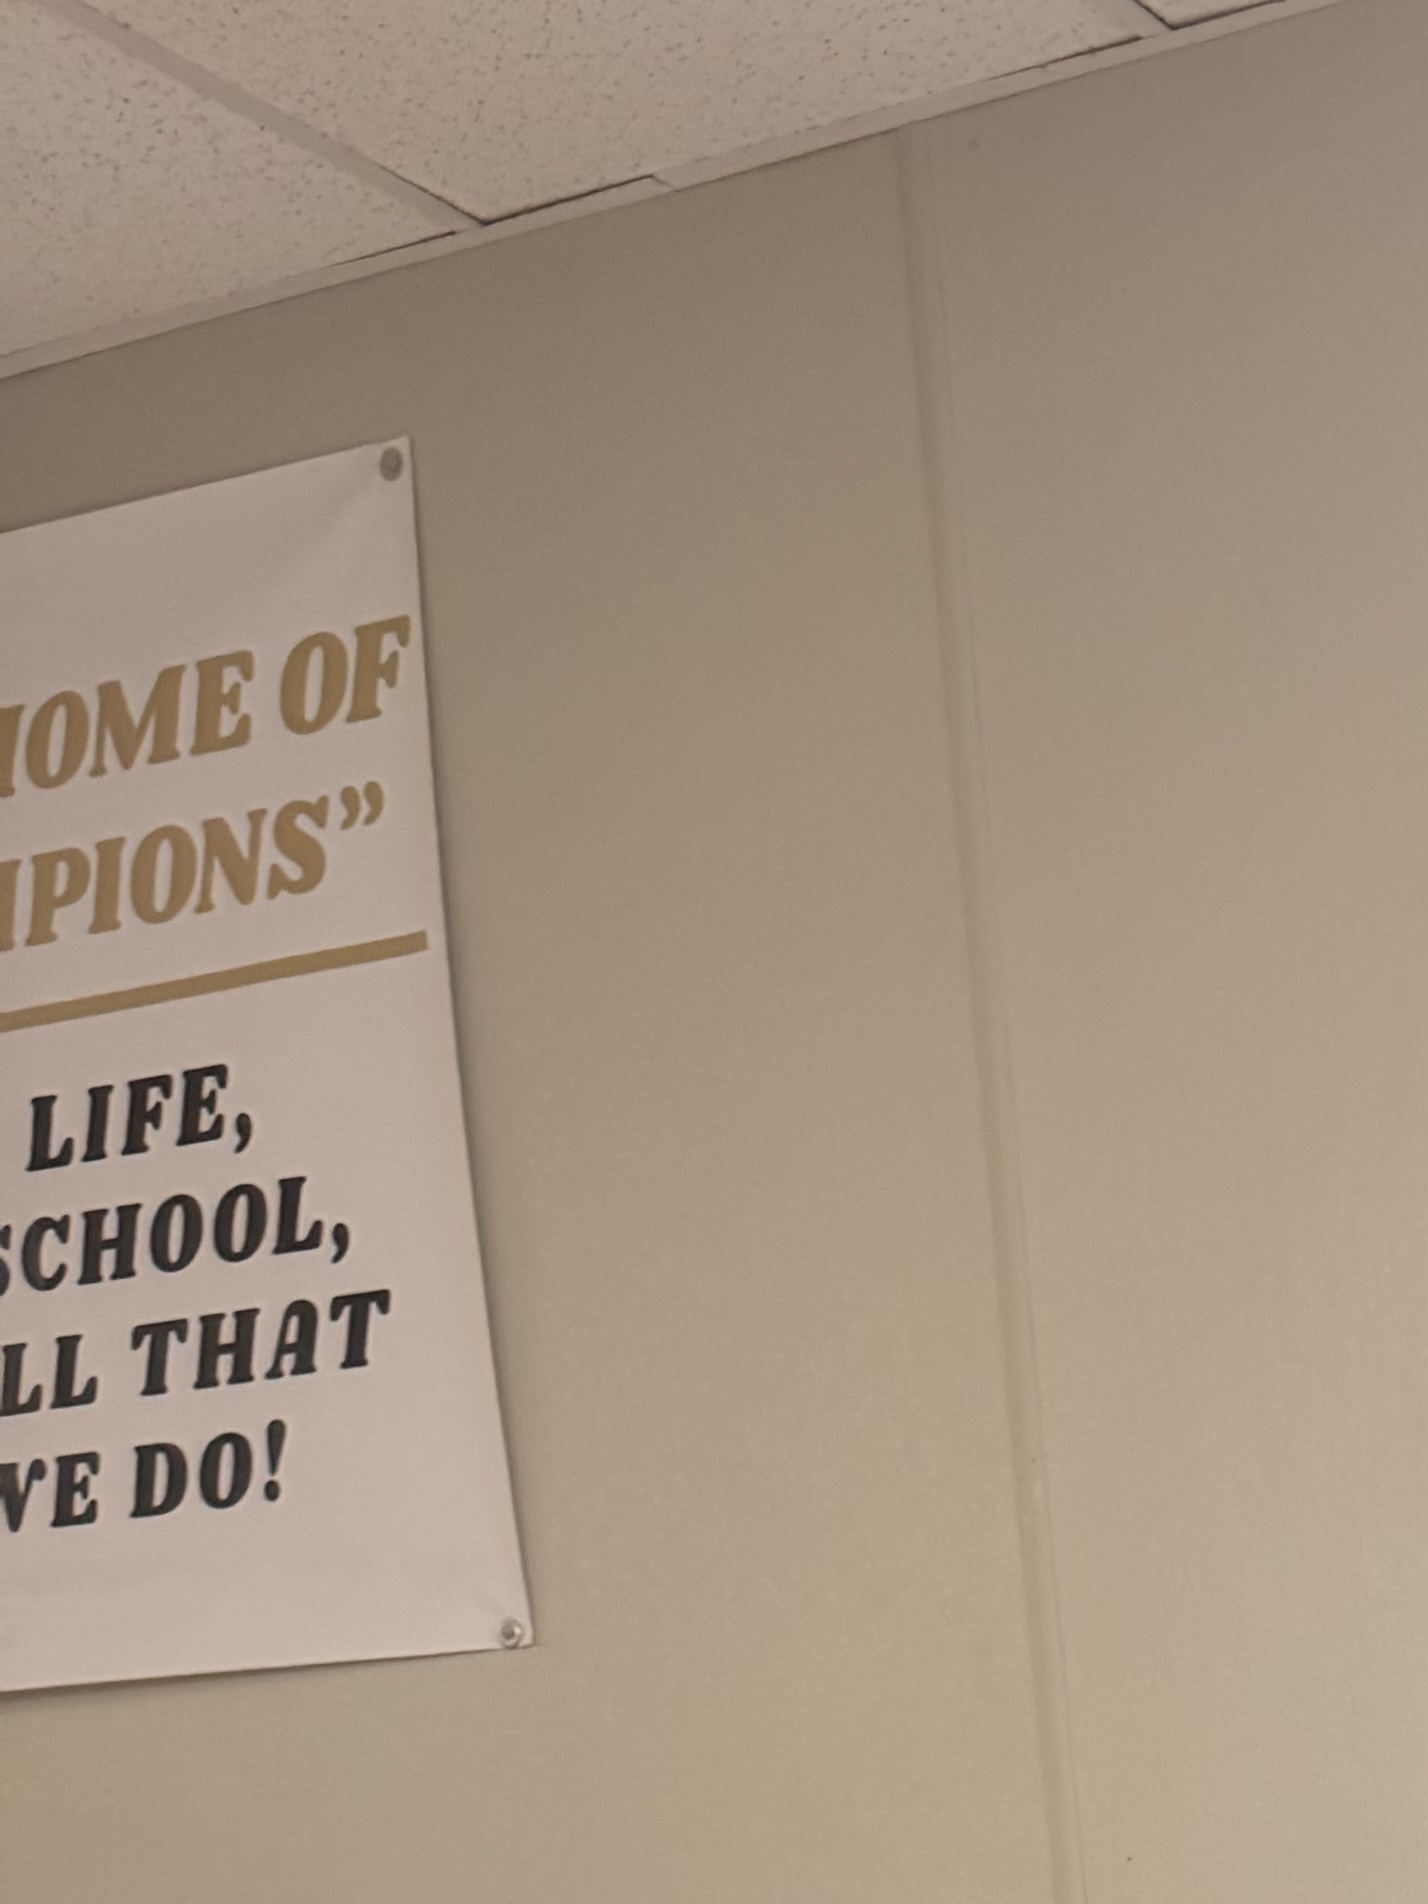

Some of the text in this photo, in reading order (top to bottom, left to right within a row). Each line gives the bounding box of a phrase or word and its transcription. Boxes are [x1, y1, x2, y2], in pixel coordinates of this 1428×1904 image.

[0, 613, 411, 798] OME OF
[0, 780, 385, 952] PIONS”
[25, 1063, 253, 1172] LIFE,
[0, 1175, 350, 1297] CHOOL,
[130, 1288, 391, 1397] THAT
[128, 1418, 287, 1519] DO!
